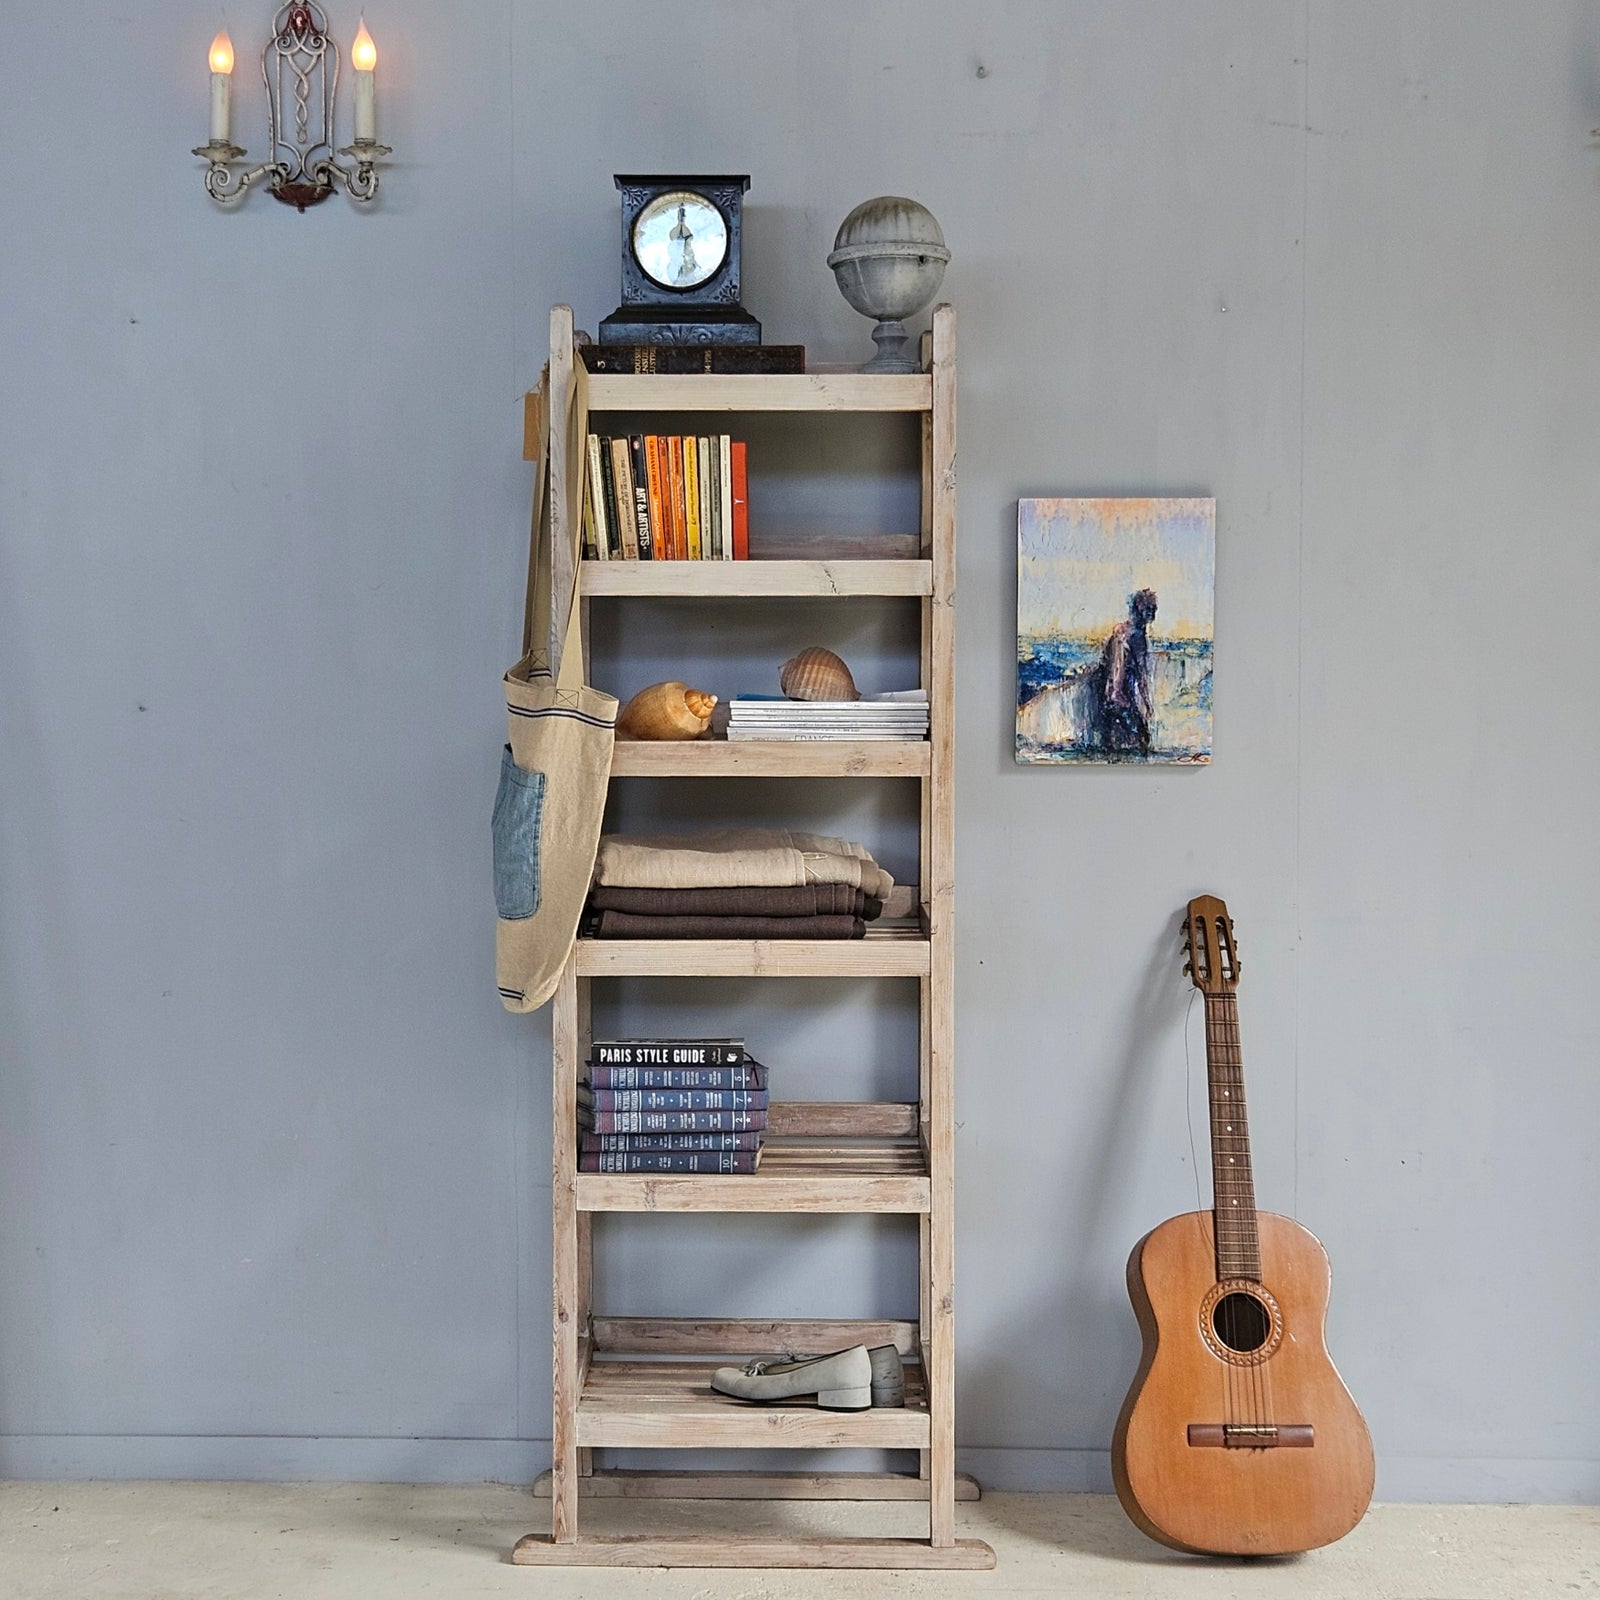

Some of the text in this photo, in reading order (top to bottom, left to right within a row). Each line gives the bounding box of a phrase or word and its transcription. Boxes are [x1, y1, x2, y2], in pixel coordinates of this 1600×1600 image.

[635, 487, 646, 504] ART
[636, 503, 647, 512] &
[637, 512, 649, 547] ARTISTS
[600, 1048, 632, 1063] PARIS
[636, 1048, 668, 1063] STYLE
[673, 1049, 705, 1064] GUIDE
[722, 1159, 730, 1169] 10
